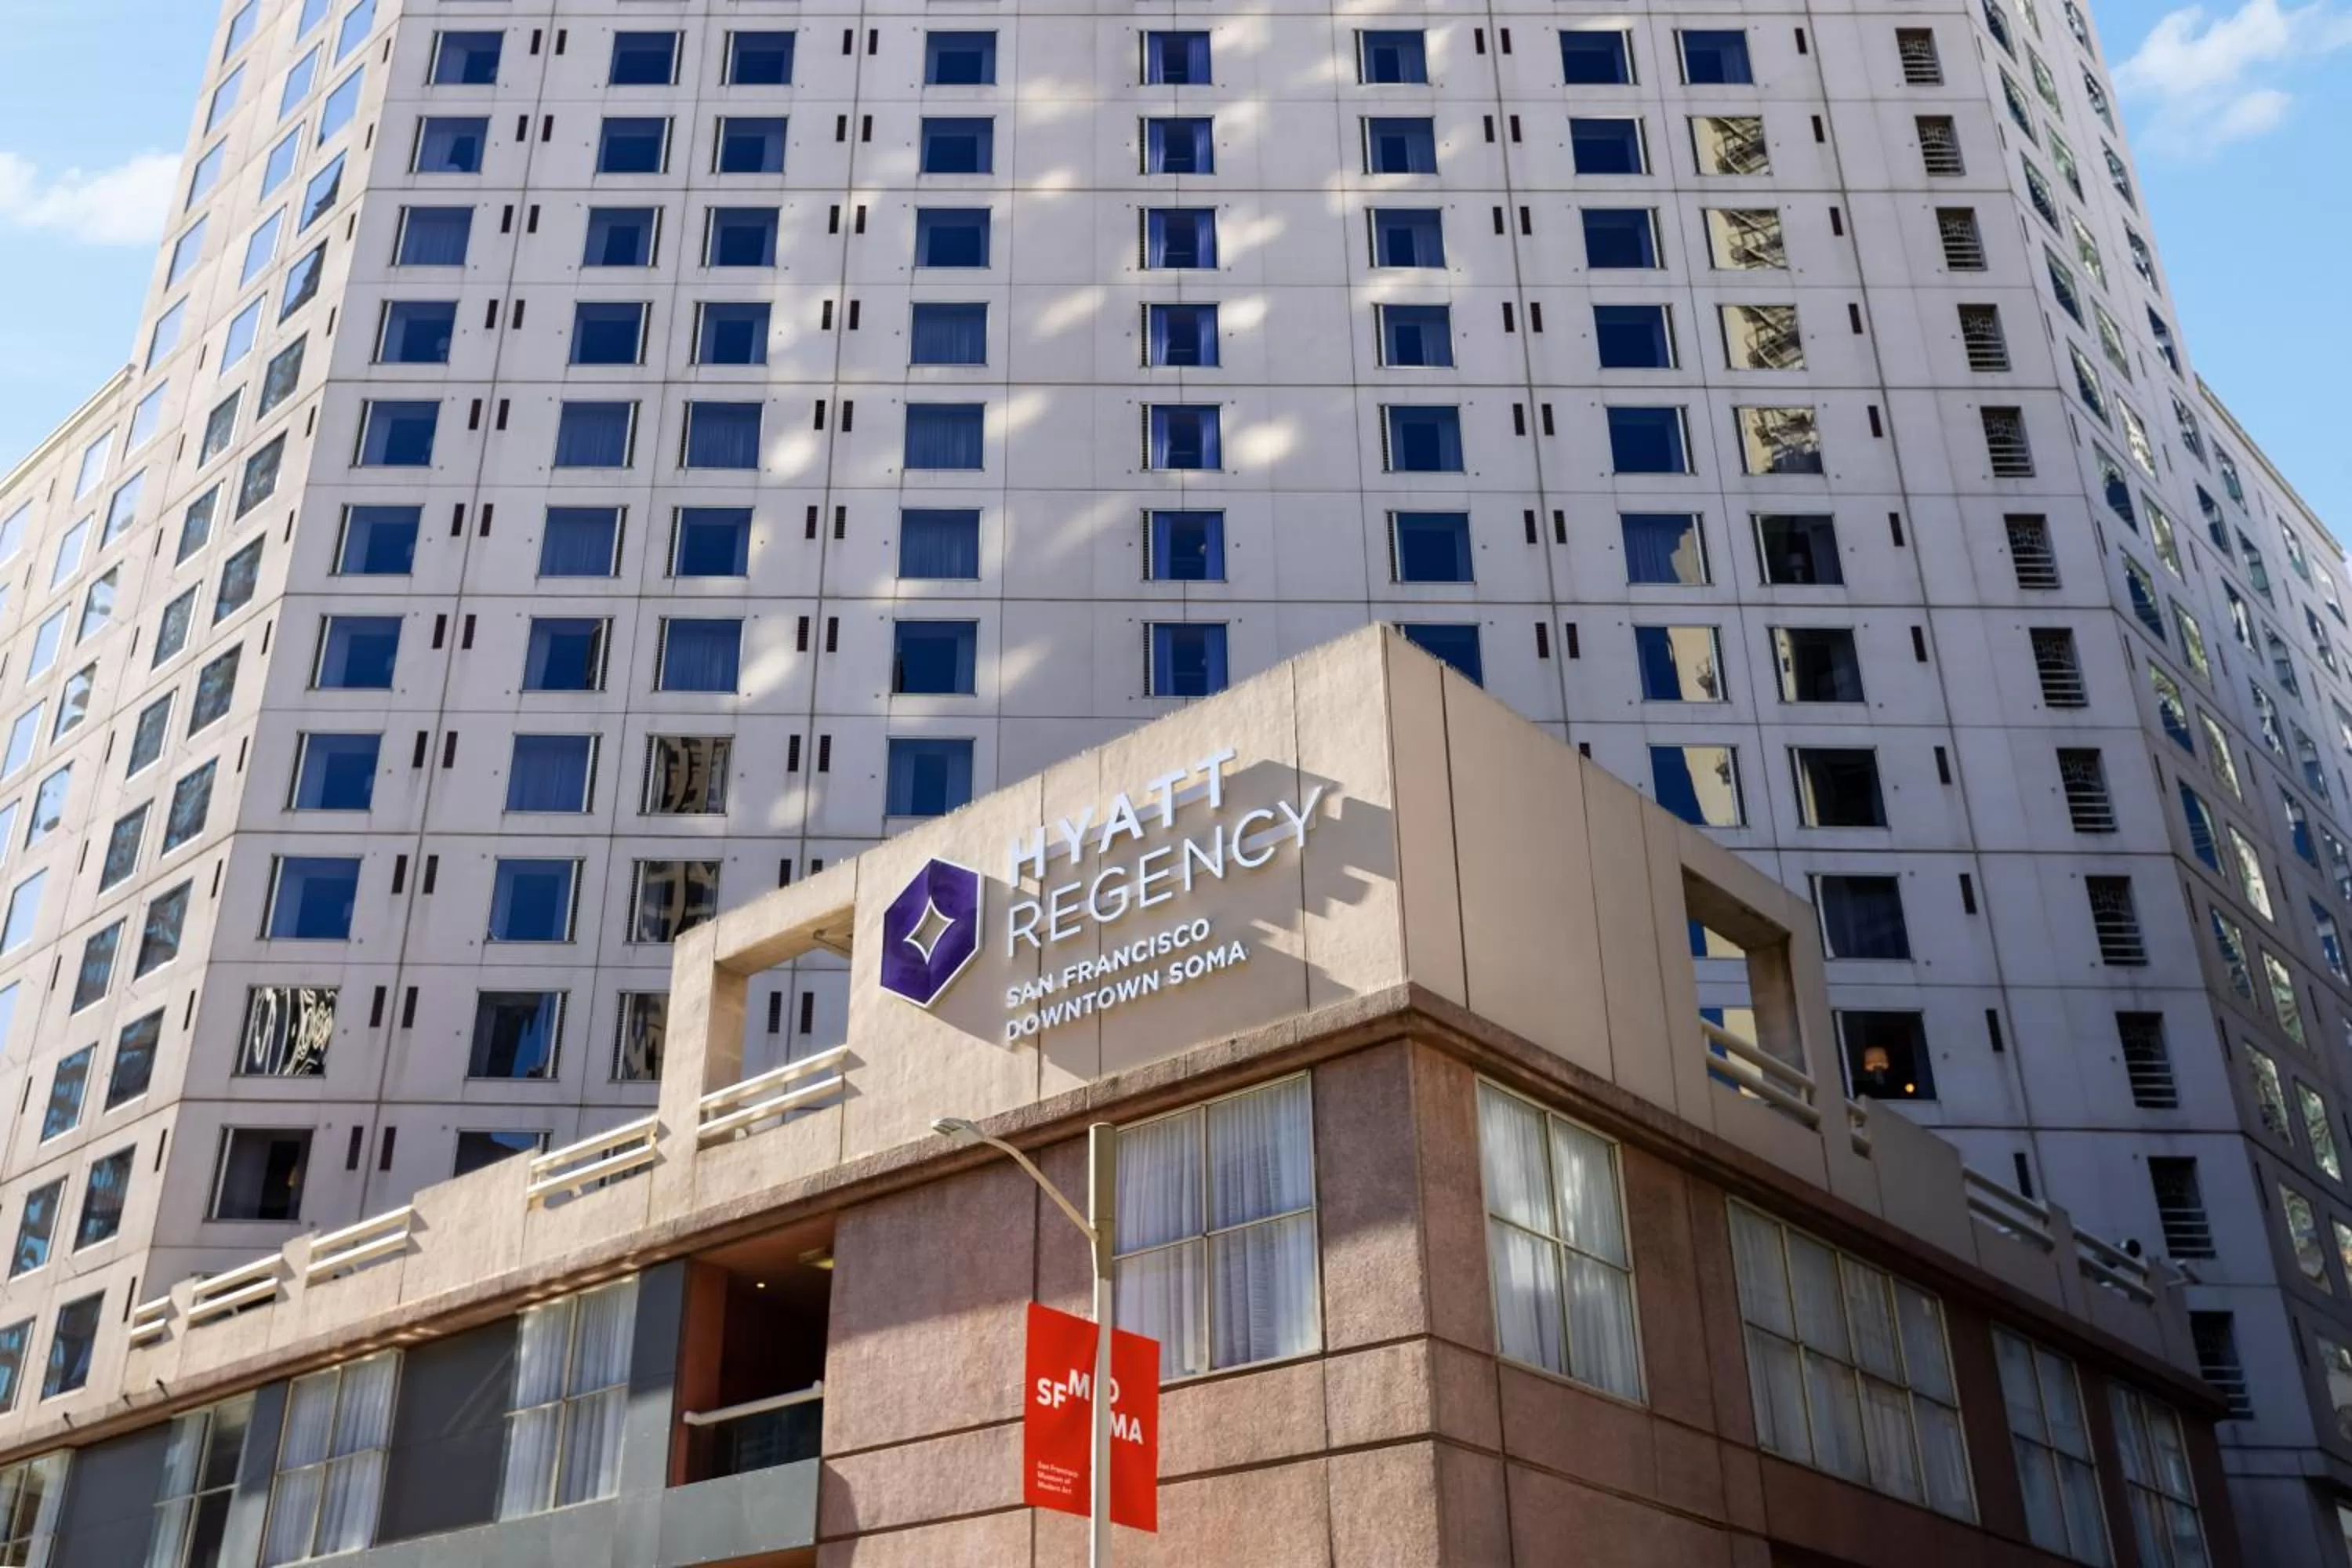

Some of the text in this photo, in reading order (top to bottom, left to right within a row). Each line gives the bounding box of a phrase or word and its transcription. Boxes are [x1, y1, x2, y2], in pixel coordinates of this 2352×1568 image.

[1006, 786, 1325, 957] REGENCY
[1009, 747, 1237, 888] HYATT
[1004, 918, 1210, 1009] SAN FRANCISCO
[1005, 941, 1246, 1042] DOWNTOWN SOMA
